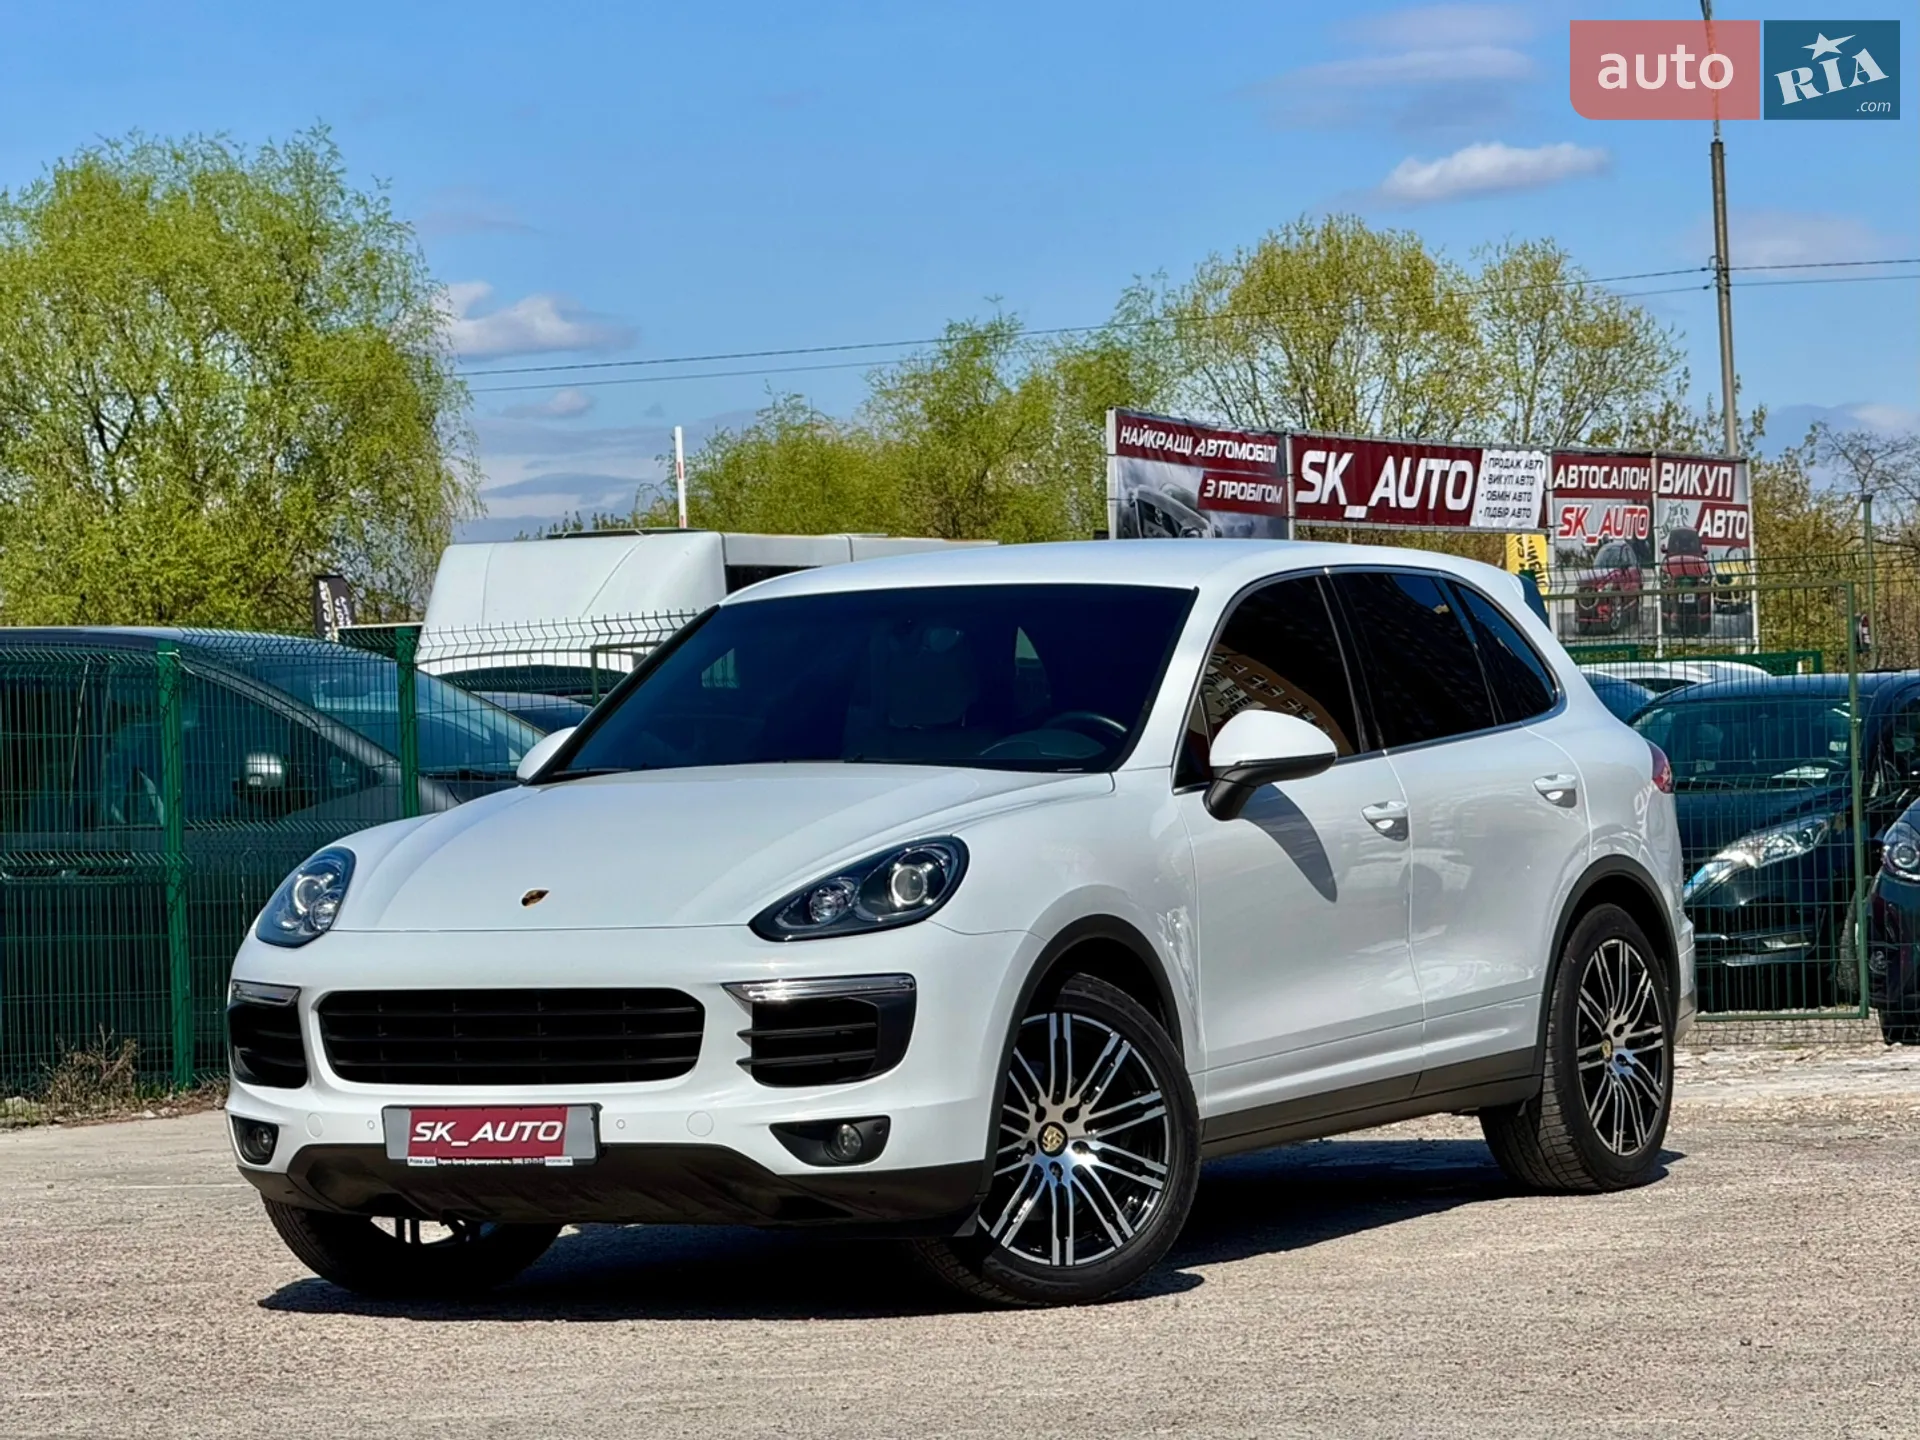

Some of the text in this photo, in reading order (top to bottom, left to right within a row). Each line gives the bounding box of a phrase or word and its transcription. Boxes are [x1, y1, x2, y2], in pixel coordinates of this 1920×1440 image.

[1488, 457, 1522, 470] ПРОДАЖ
[1295, 451, 1474, 519] SK_AUTO
[1515, 474, 1535, 486] АВТО
[1554, 464, 1650, 491] АВТОСАЛОН
[1658, 462, 1731, 498] ВИКУП
[1218, 480, 1284, 504] ПРОБІГОМ
[1486, 490, 1532, 502] ОБМІН АВТО
[1510, 507, 1532, 519] АВТО
[1559, 505, 1650, 544] SK_AUTO
[1699, 509, 1747, 541] АВТО
[411, 1121, 564, 1147] SK_AUTO
